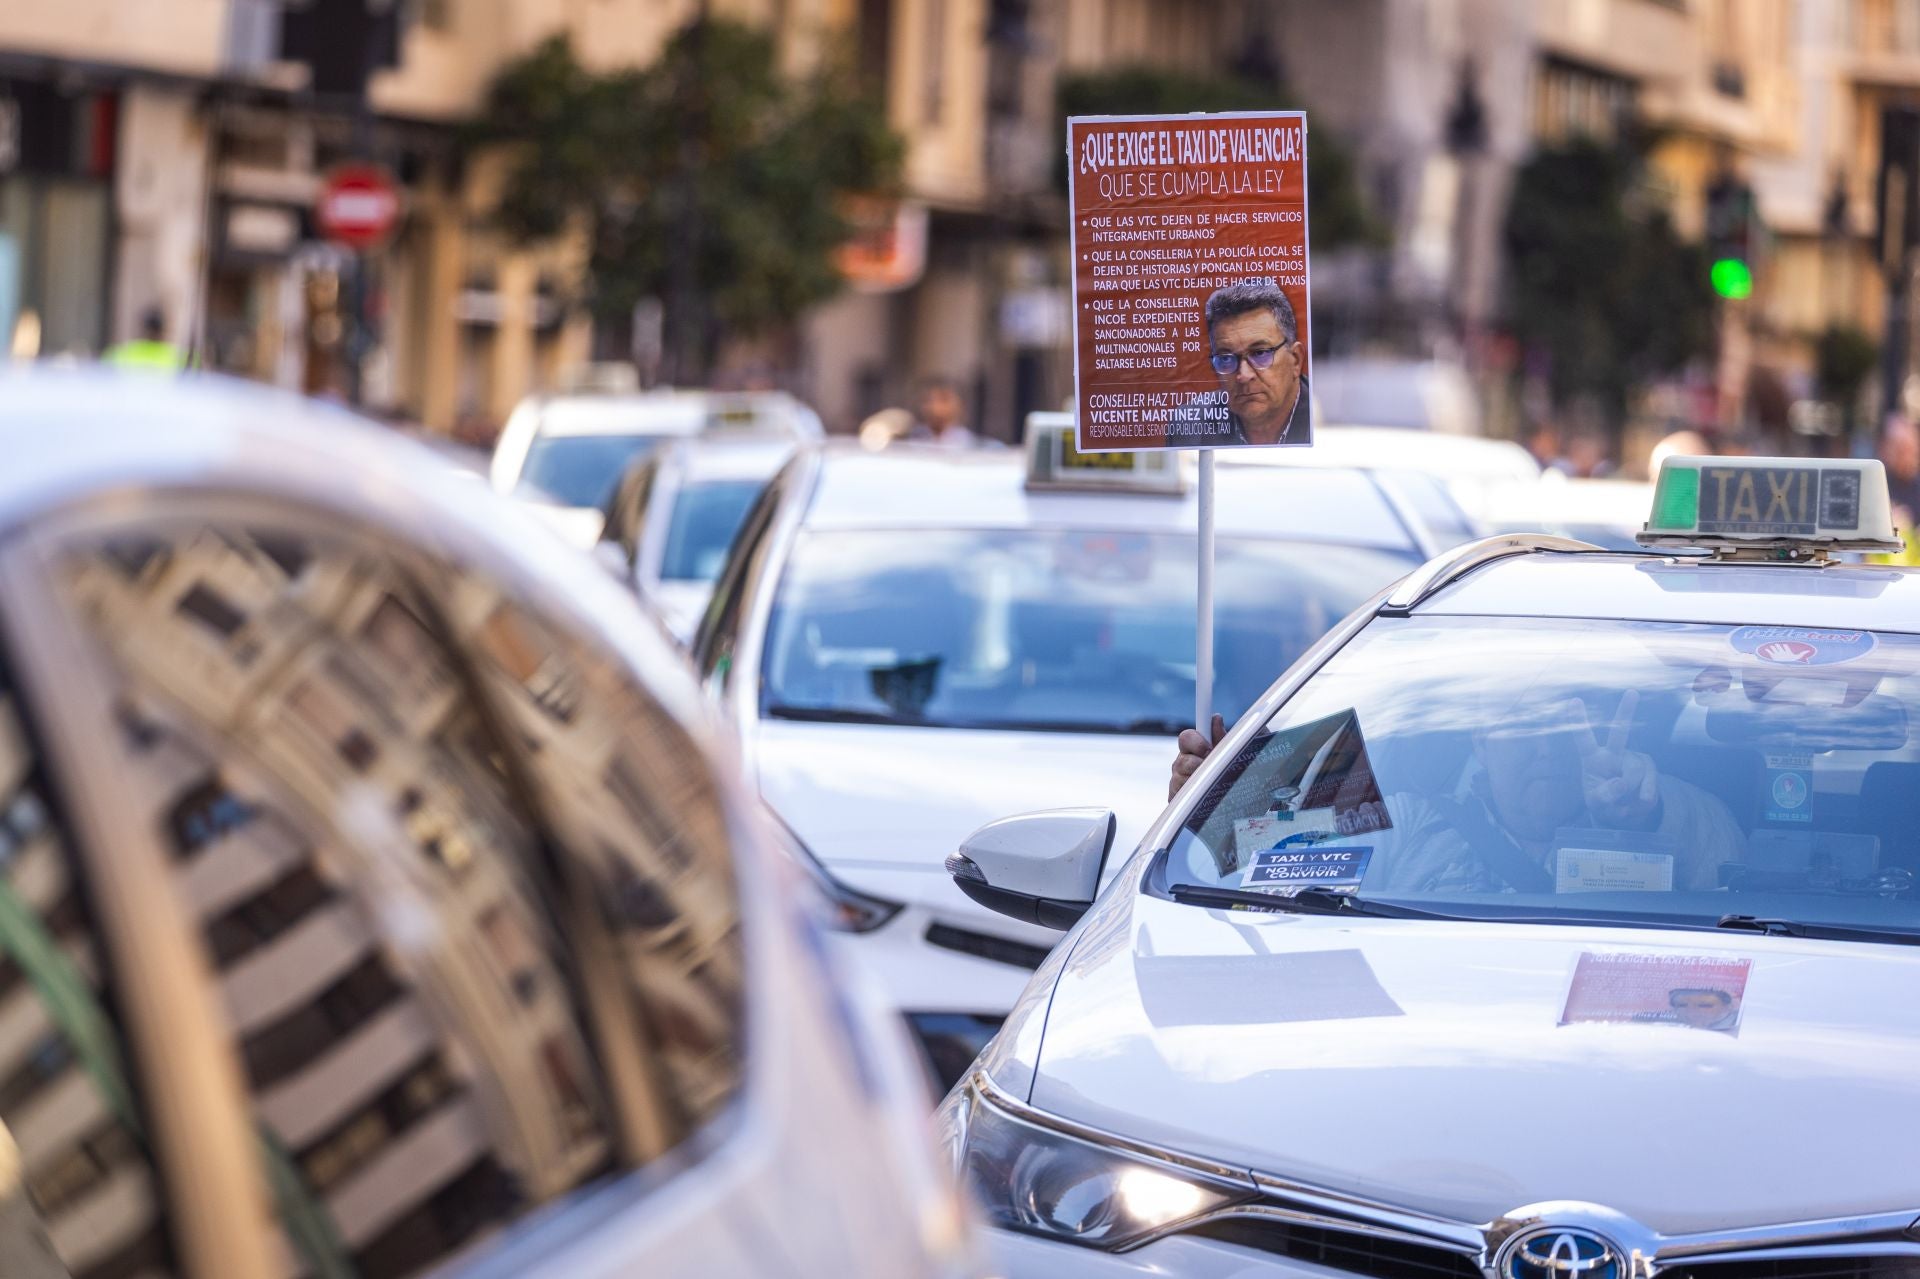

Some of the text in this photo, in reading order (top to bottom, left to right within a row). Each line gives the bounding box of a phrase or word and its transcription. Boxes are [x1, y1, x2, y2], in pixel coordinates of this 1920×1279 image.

[1080, 128, 1301, 175] ¿QUE EXIGE EL TAXI DE VALENCIA?
[1099, 169, 1284, 201] QUE SE CUMPLA LA LEY
[1091, 212, 1302, 228] QUE LAS VTC DEJEN DE HACER SERVICIOS
[1092, 229, 1215, 242] INTEGRAMENTE URBANOS
[1091, 245, 1303, 263] QUE LA CONSELLERIA Y LA POLICÍA LOCAL SE
[1093, 260, 1303, 276] DEJEN DE HISTORIAS Y PONGAN LOS MEDIOS
[1094, 275, 1306, 292] PARA QUE LAS VTC DEJEN DE HACER DE TAXIS
[1093, 298, 1199, 311] QUE LA CONSELLERIA
[1094, 312, 1200, 325] INCOE EXPEDIENTES
[1095, 327, 1200, 340] SANCIONADORES A LAS
[1096, 341, 1200, 354] MULTINACIONALES POR
[1096, 357, 1177, 369] SALTARSE LAS LEYES
[1090, 391, 1229, 408] CONSELLER HAZ TU TRABAJO
[1090, 407, 1229, 423] VICENTE MARTINEZ MUS
[1090, 425, 1133, 437] RESPONSABLE
[1134, 424, 1146, 437] DEL
[1147, 423, 1174, 436] SERVICIO
[1204, 422, 1216, 435] DEL
[1217, 422, 1231, 434] TAXI
[1711, 470, 1809, 522] TAXI
[1714, 523, 1801, 534] VALENCIA
[1270, 853, 1352, 863] TAXI Y VTC
[1269, 870, 1339, 879] CONVIVIR
